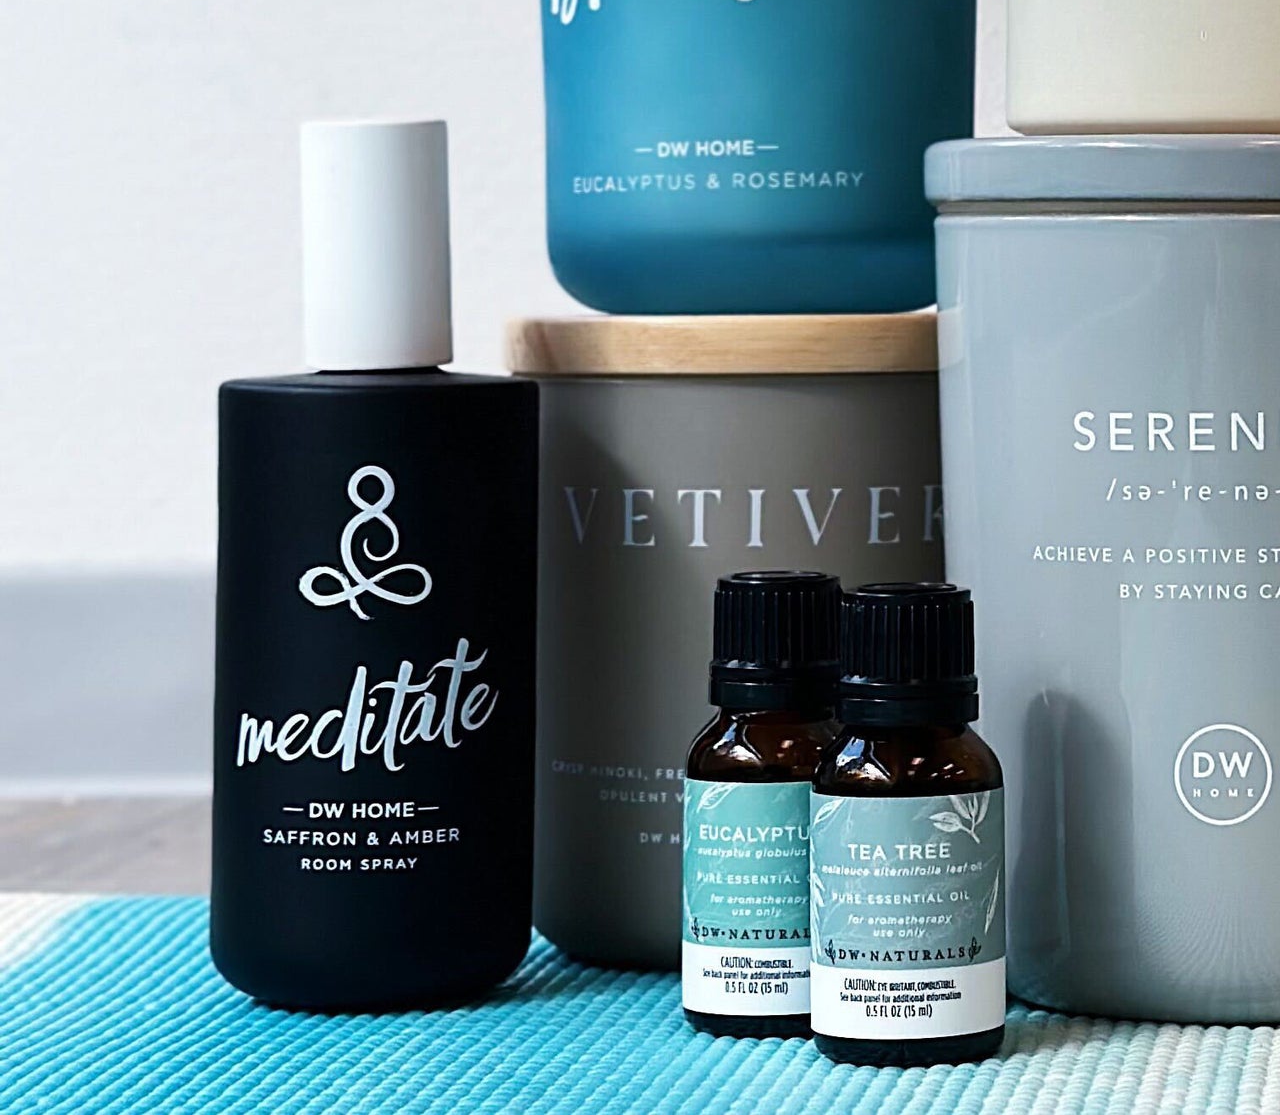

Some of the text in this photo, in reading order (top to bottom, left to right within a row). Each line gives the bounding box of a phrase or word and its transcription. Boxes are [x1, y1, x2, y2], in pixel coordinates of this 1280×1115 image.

[656, 138, 756, 158] DW HOME
[572, 170, 865, 194] EUCALYPTUS & ROSEMARY
[1032, 545, 1114, 564] ACHIEVE
[1121, 547, 1136, 564] A
[1144, 547, 1247, 565] POSITIVE
[1118, 583, 1144, 600] BY
[1153, 583, 1249, 601] STAYING
[236, 637, 500, 772] meditate
[1192, 751, 1254, 778] DW
[655, 768, 685, 781] FRE
[1191, 787, 1256, 799] HOME
[308, 801, 416, 819] DW HOME
[262, 827, 461, 846] SAFFRON & AMBER
[699, 823, 811, 843] EUCALYPTU
[754, 846, 807, 860] globulus
[847, 842, 952, 861] TEA TREE
[300, 856, 419, 871] ROOM SPRAY
[697, 870, 723, 884] PURE
[726, 873, 801, 885] ESSENTIAL
[709, 893, 724, 904] for
[831, 890, 971, 905] PURE ESSENTIAL OIL
[731, 908, 751, 917] use
[847, 913, 953, 926] for aromatherapy
[872, 928, 894, 938] use
[865, 1004, 878, 1017] 0.5
[890, 1004, 901, 1018] OZ
